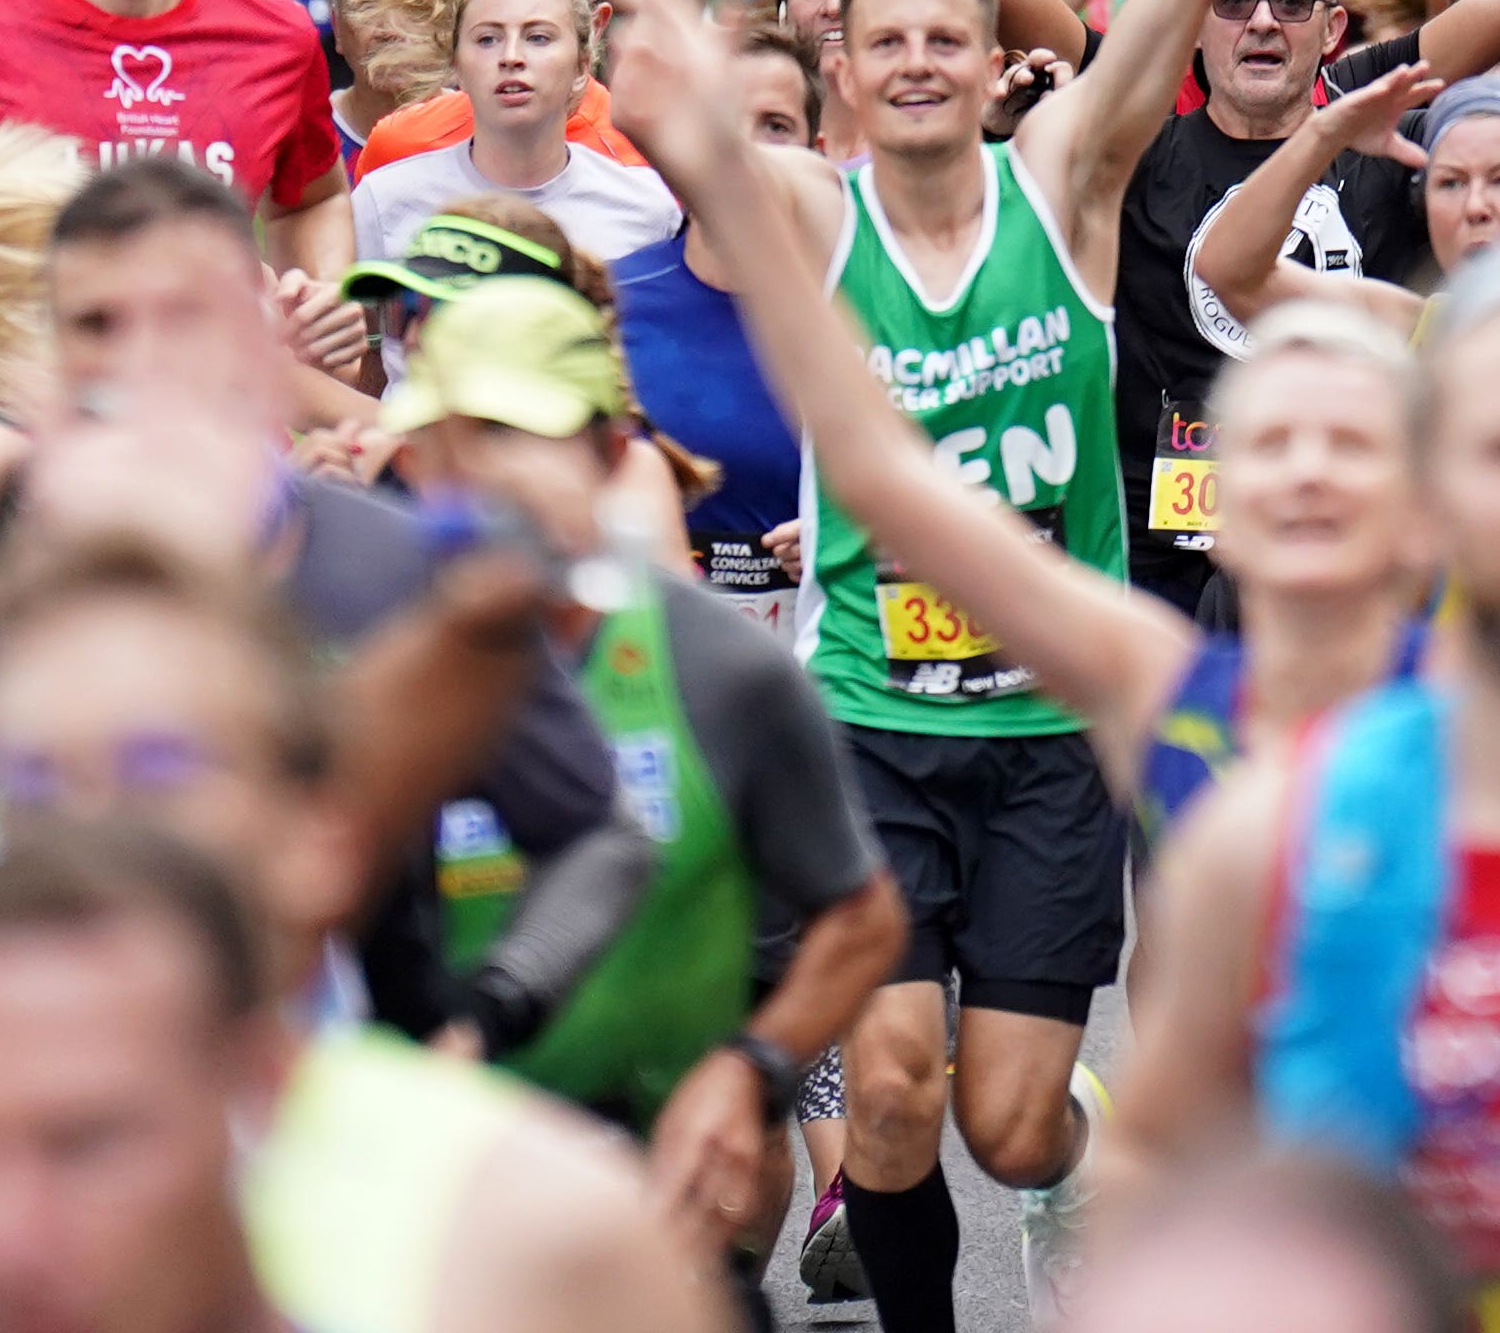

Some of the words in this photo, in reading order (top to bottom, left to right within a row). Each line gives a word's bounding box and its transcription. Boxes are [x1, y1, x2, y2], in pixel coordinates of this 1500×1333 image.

[866, 305, 1071, 388] ACMILLAN
[944, 346, 1065, 406] SUPPORT
[1171, 411, 1221, 452] tc
[711, 542, 752, 557] TATA
[710, 570, 770, 586] SERVICES
